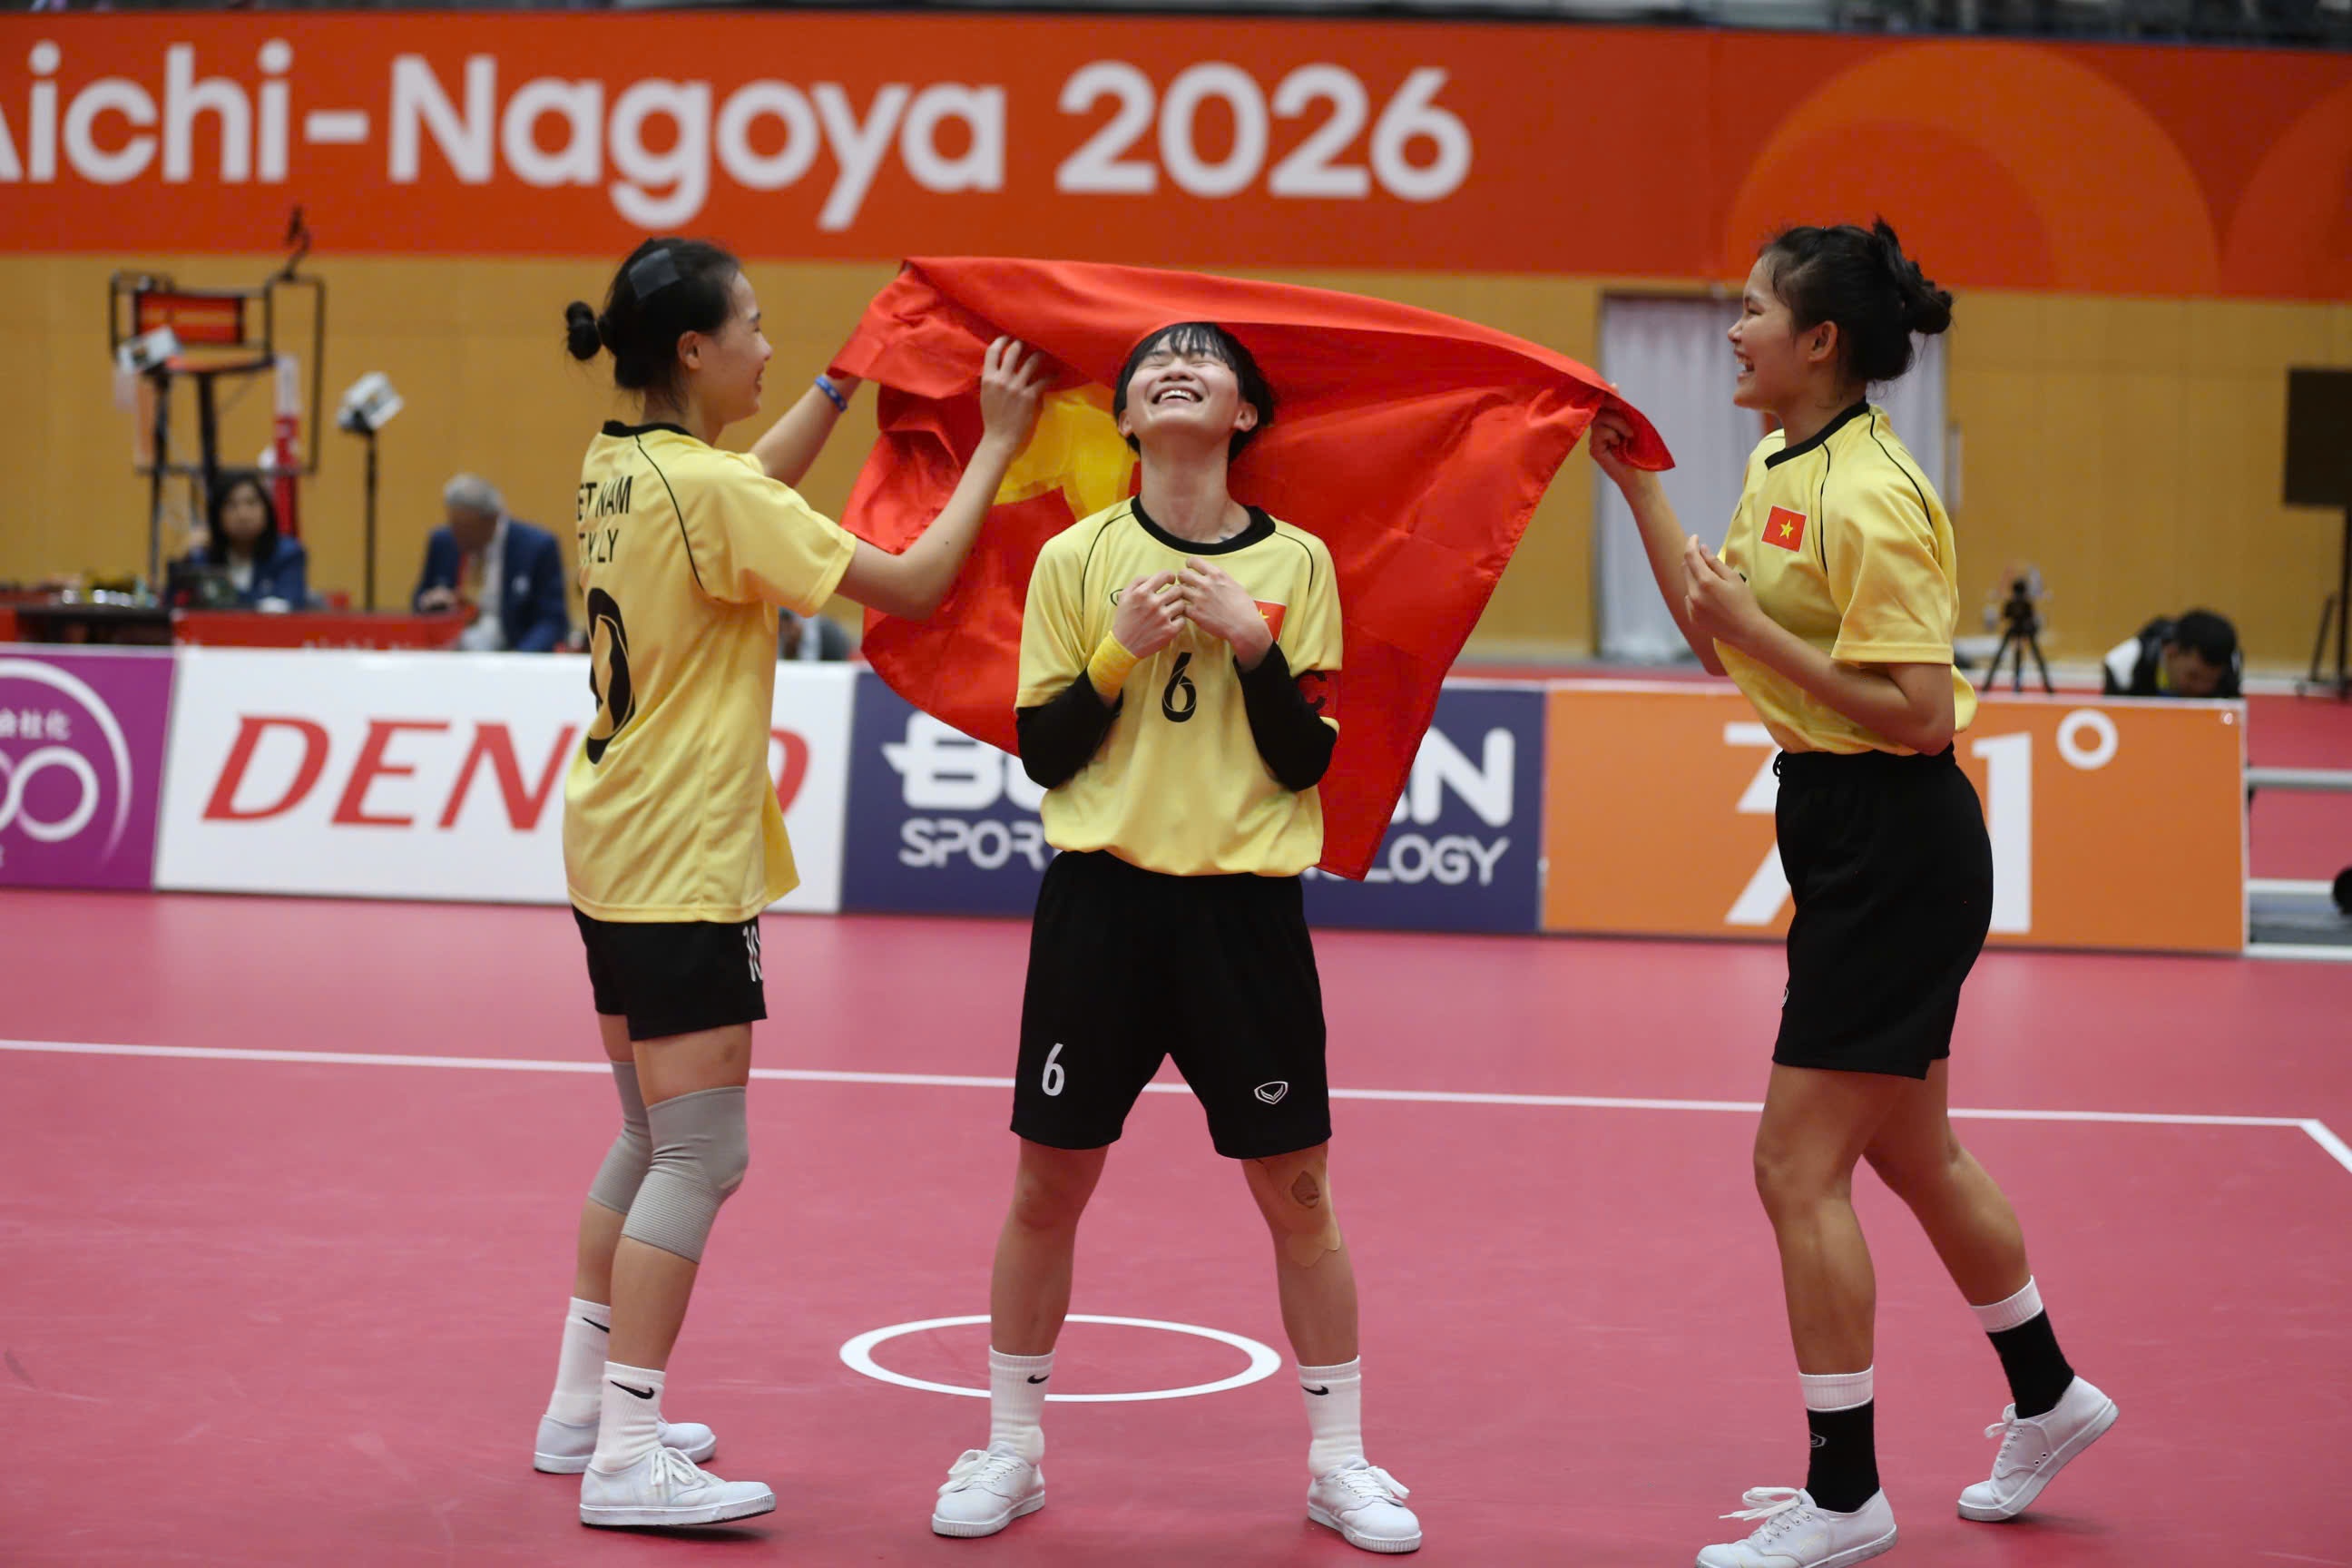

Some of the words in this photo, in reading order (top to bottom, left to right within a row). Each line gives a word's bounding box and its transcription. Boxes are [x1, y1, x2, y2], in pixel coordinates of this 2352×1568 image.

[1055, 60, 1472, 201] 2026
[1162, 652, 1197, 722] 6
[201, 712, 809, 831] DEN
[898, 818, 1047, 870] SPOR
[1042, 1043, 1065, 1096] 6
